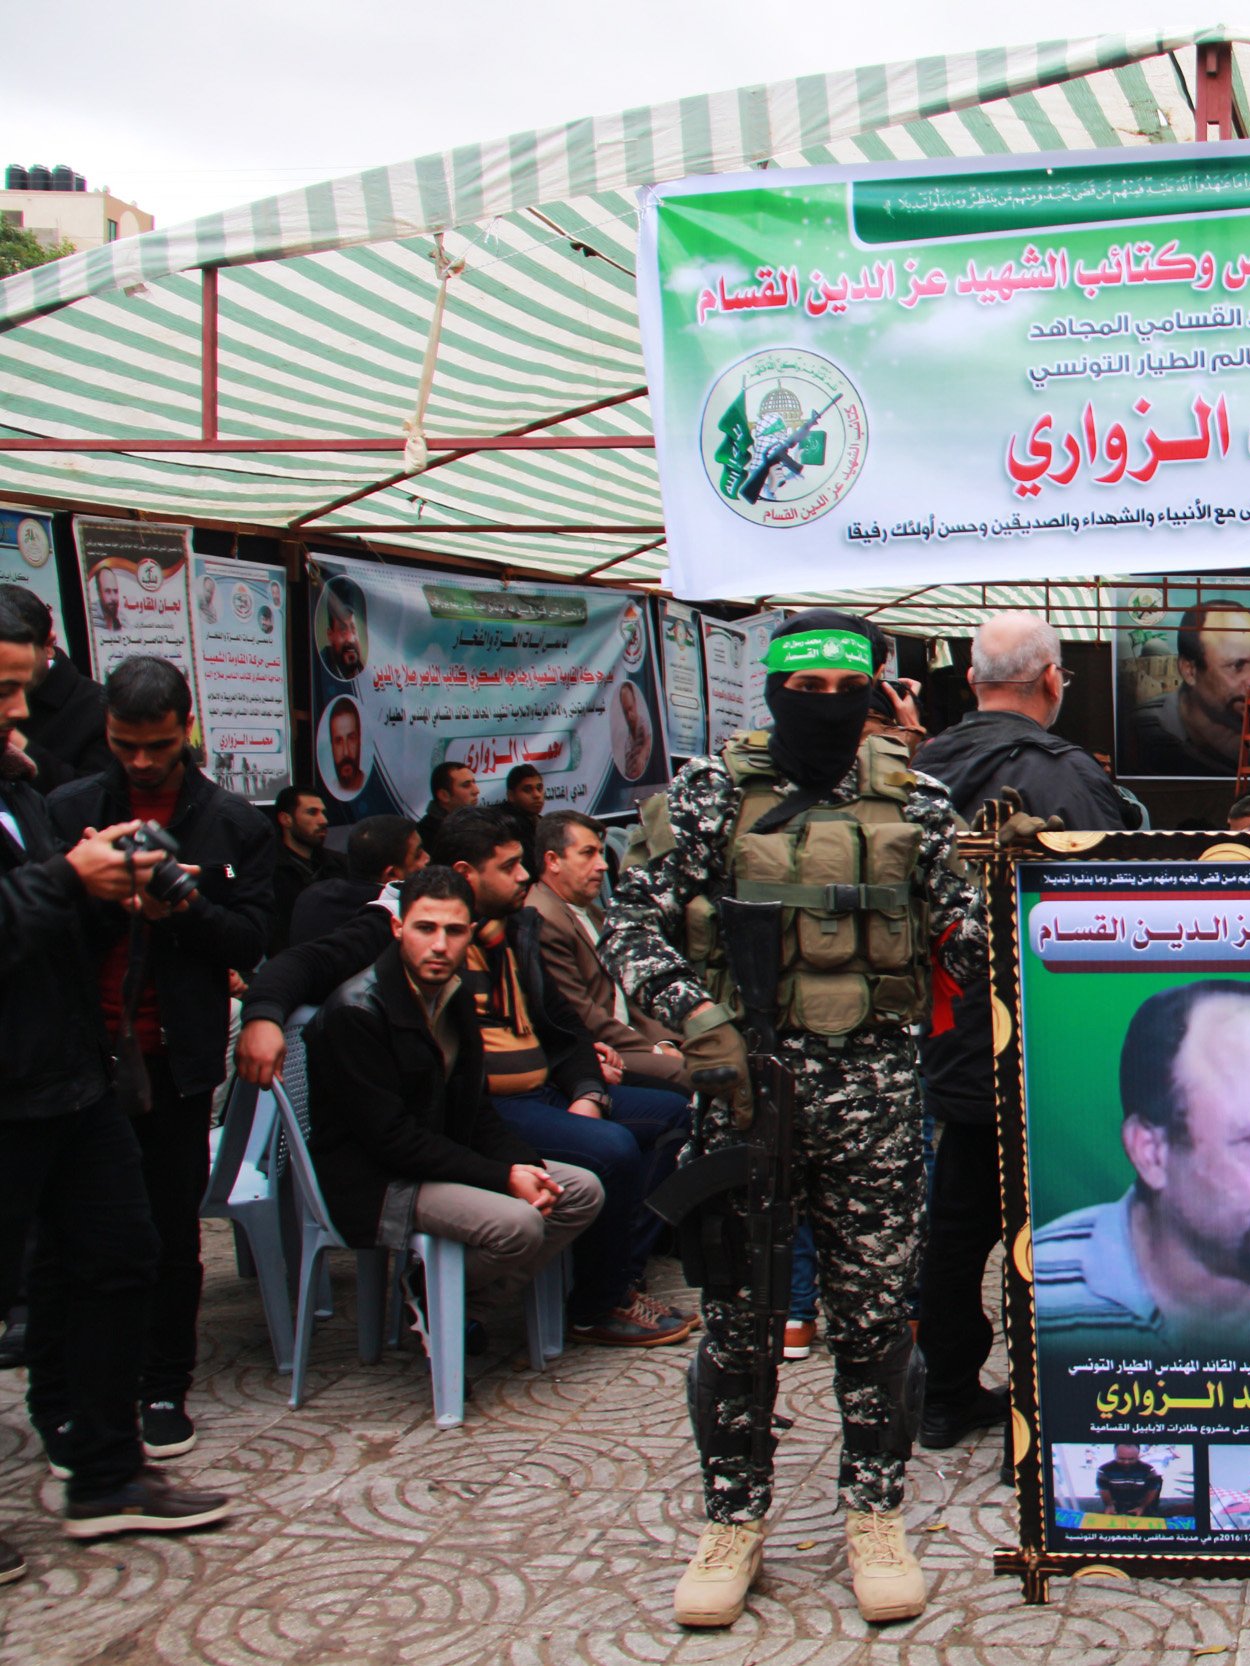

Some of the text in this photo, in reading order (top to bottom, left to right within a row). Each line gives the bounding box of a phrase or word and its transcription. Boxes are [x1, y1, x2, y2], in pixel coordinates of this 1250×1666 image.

[957, 245, 1068, 301] الشهيد
[1075, 241, 1212, 298] وكتائب
[805, 262, 895, 314] الدين
[903, 258, 948, 306] عز
[698, 268, 799, 323] القسام
[1030, 316, 1129, 340] المجاهد
[1136, 307, 1240, 341] القسامي
[1028, 355, 1130, 387] التونسي
[1137, 350, 1205, 375] الطيار
[1008, 393, 1229, 497] الزواري
[991, 510, 1080, 536] والصديقين
[1081, 507, 1155, 530] والشهداء
[1158, 498, 1211, 528] الأنبياء
[1214, 505, 1236, 524] مع
[848, 520, 888, 544] رفيقا
[891, 513, 935, 540] أولئك
[938, 518, 987, 538] وحسن
[1038, 913, 1127, 951] القسام
[1131, 914, 1229, 950] الدين
[1068, 1358, 1114, 1376] التونسي
[1116, 1359, 1152, 1375] الطيار
[1155, 1358, 1199, 1375] المهندس
[1202, 1358, 1236, 1373] القائد
[1096, 1379, 1223, 1419] الزواري
[1090, 1422, 1130, 1434] القسامية
[1200, 1424, 1230, 1435] مشروع
[1232, 1423, 1249, 1435] على
[1065, 1532, 1097, 1542] التونسية
[1098, 1533, 1142, 1543] بالجمهورية
[1175, 1534, 1199, 1543] مدينة
[1200, 1533, 1212, 1545] في
